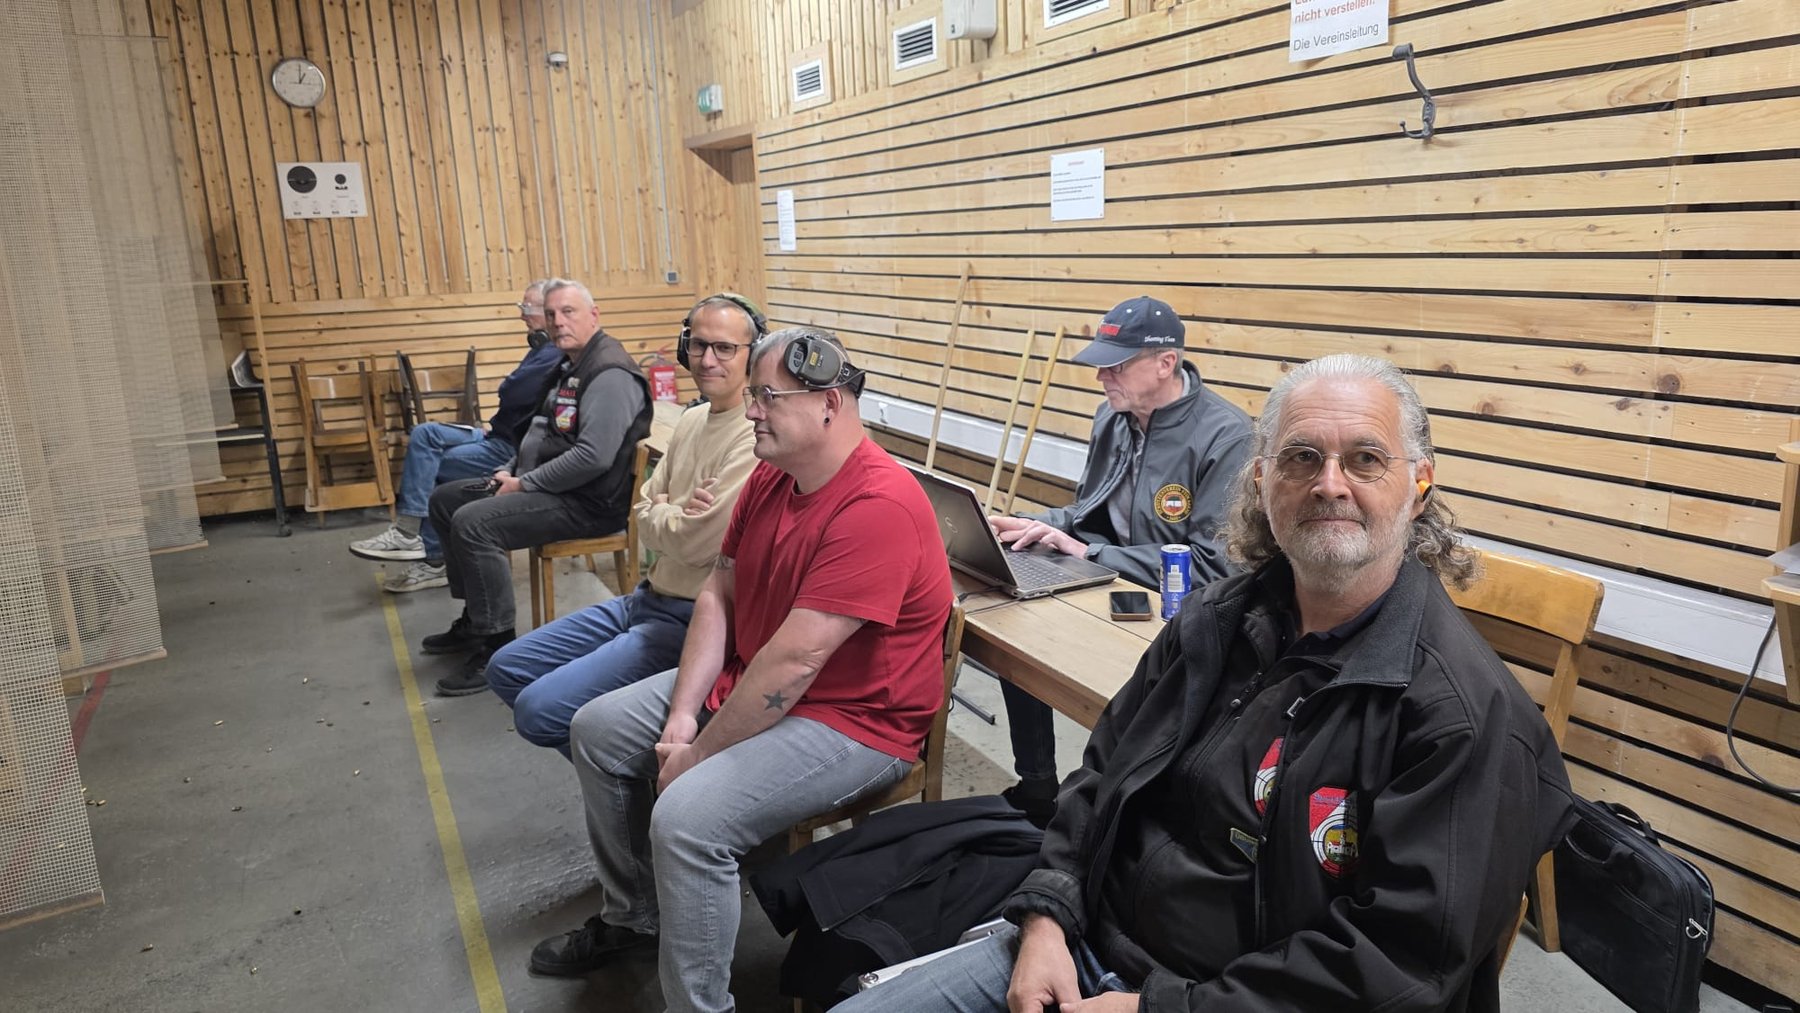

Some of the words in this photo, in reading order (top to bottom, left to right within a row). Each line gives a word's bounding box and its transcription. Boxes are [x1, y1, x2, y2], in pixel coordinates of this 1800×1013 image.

[1294, 8, 1321, 24] nicht
[1293, 39, 1310, 51] Die
[1313, 23, 1379, 47] Vereinsleitung
